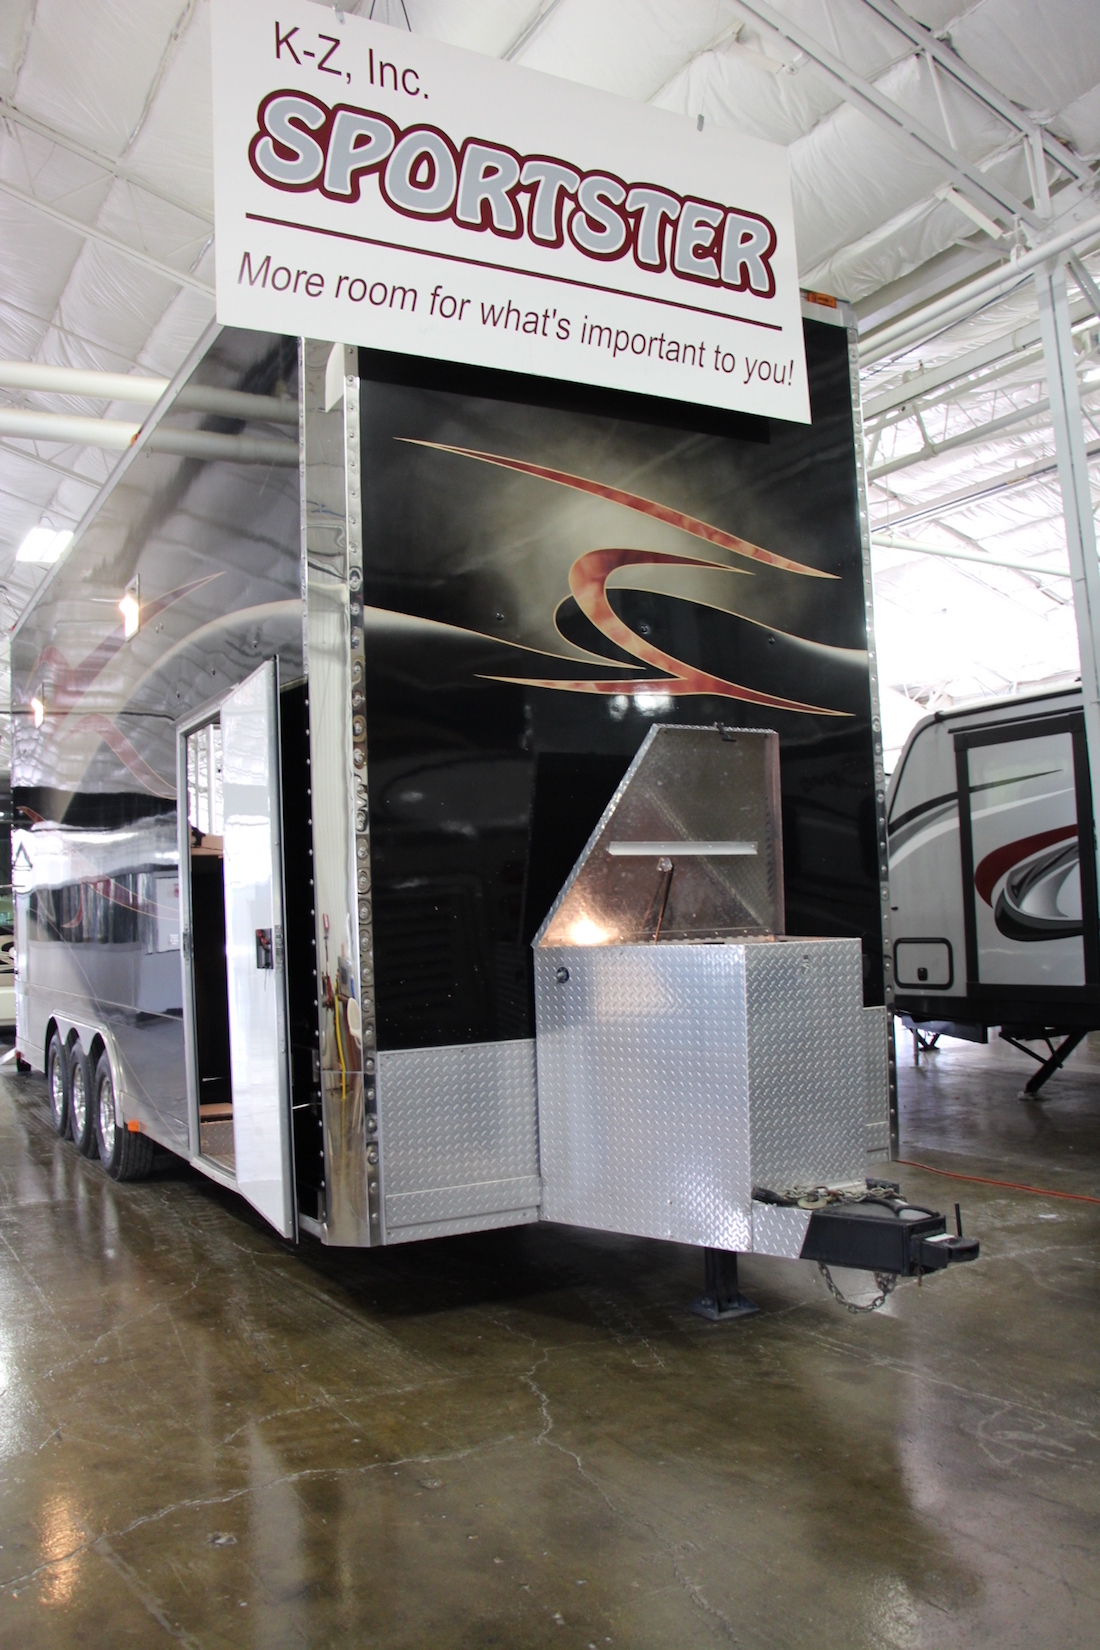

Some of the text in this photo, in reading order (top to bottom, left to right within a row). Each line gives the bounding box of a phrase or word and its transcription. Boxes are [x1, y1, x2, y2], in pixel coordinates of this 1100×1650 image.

[274, 20, 430, 100] K-Z, Inc.
[247, 89, 777, 299] SPORTSTER
[238, 251, 795, 386] More room for what's important to you!
